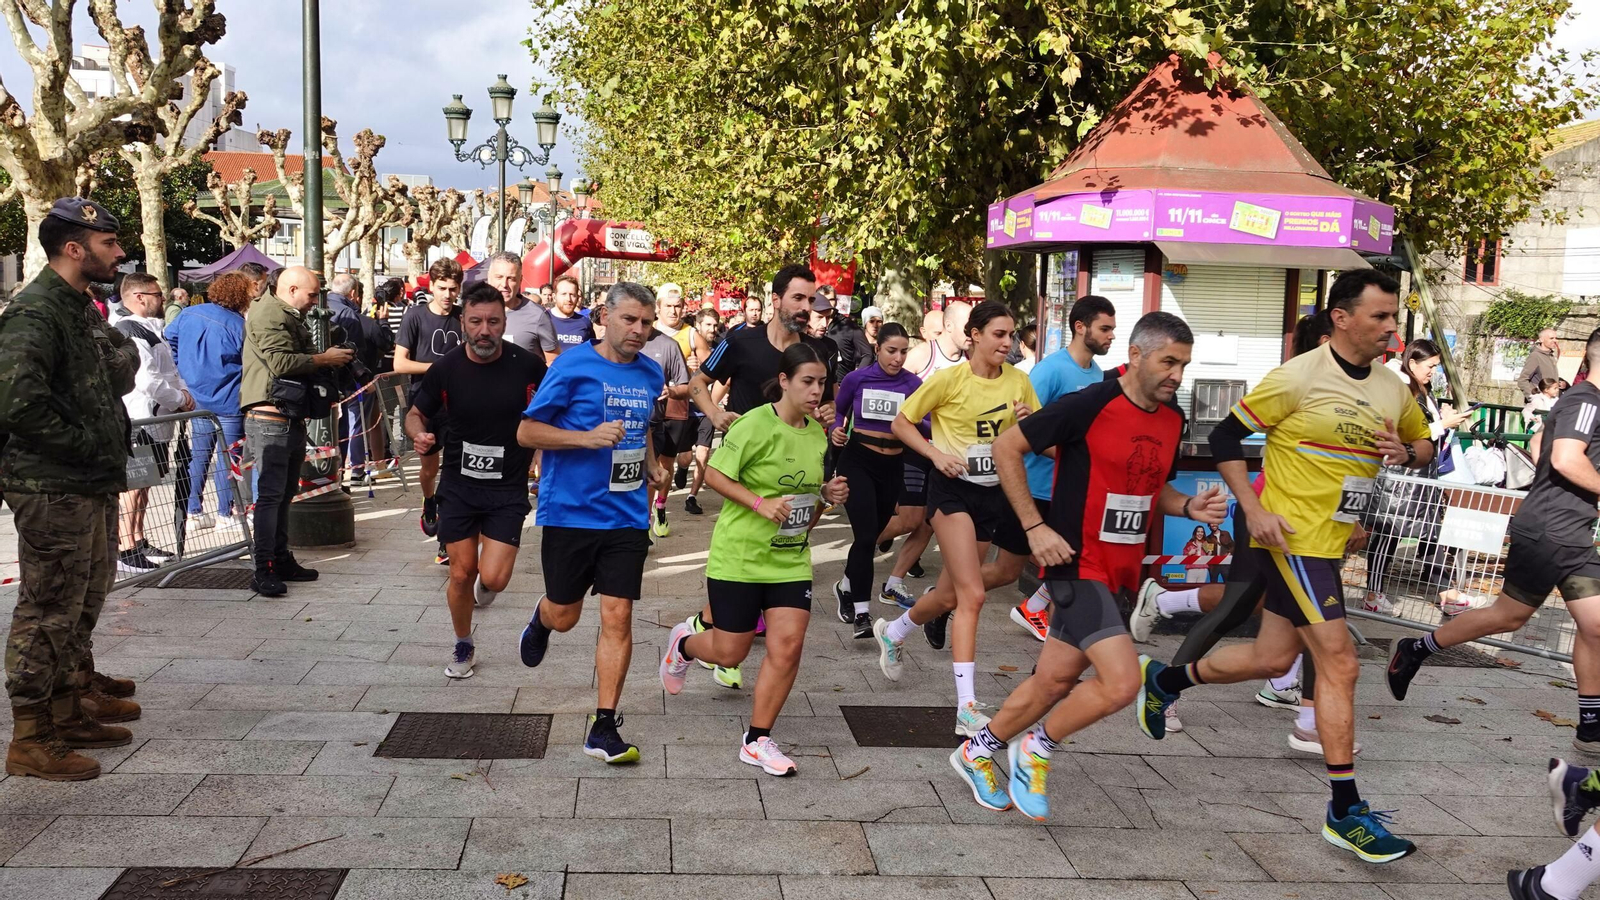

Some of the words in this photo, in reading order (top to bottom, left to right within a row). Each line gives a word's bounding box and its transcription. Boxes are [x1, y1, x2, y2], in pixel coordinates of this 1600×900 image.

[1168, 207, 1203, 226] 11/11
[1283, 217, 1319, 226] PREMIOS
[1319, 219, 1341, 233] DÁ
[609, 232, 651, 242] CONCELLO
[613, 240, 625, 248] DE
[626, 241, 646, 249] VIGO
[607, 395, 648, 409] ÉRGUETE
[868, 400, 892, 413] 560
[624, 409, 632, 418] E
[976, 419, 1004, 438] EY
[468, 455, 495, 470] 262
[618, 463, 641, 480] 239
[1344, 492, 1367, 510] 220
[788, 507, 811, 525] 504
[1115, 511, 1142, 530] 170
